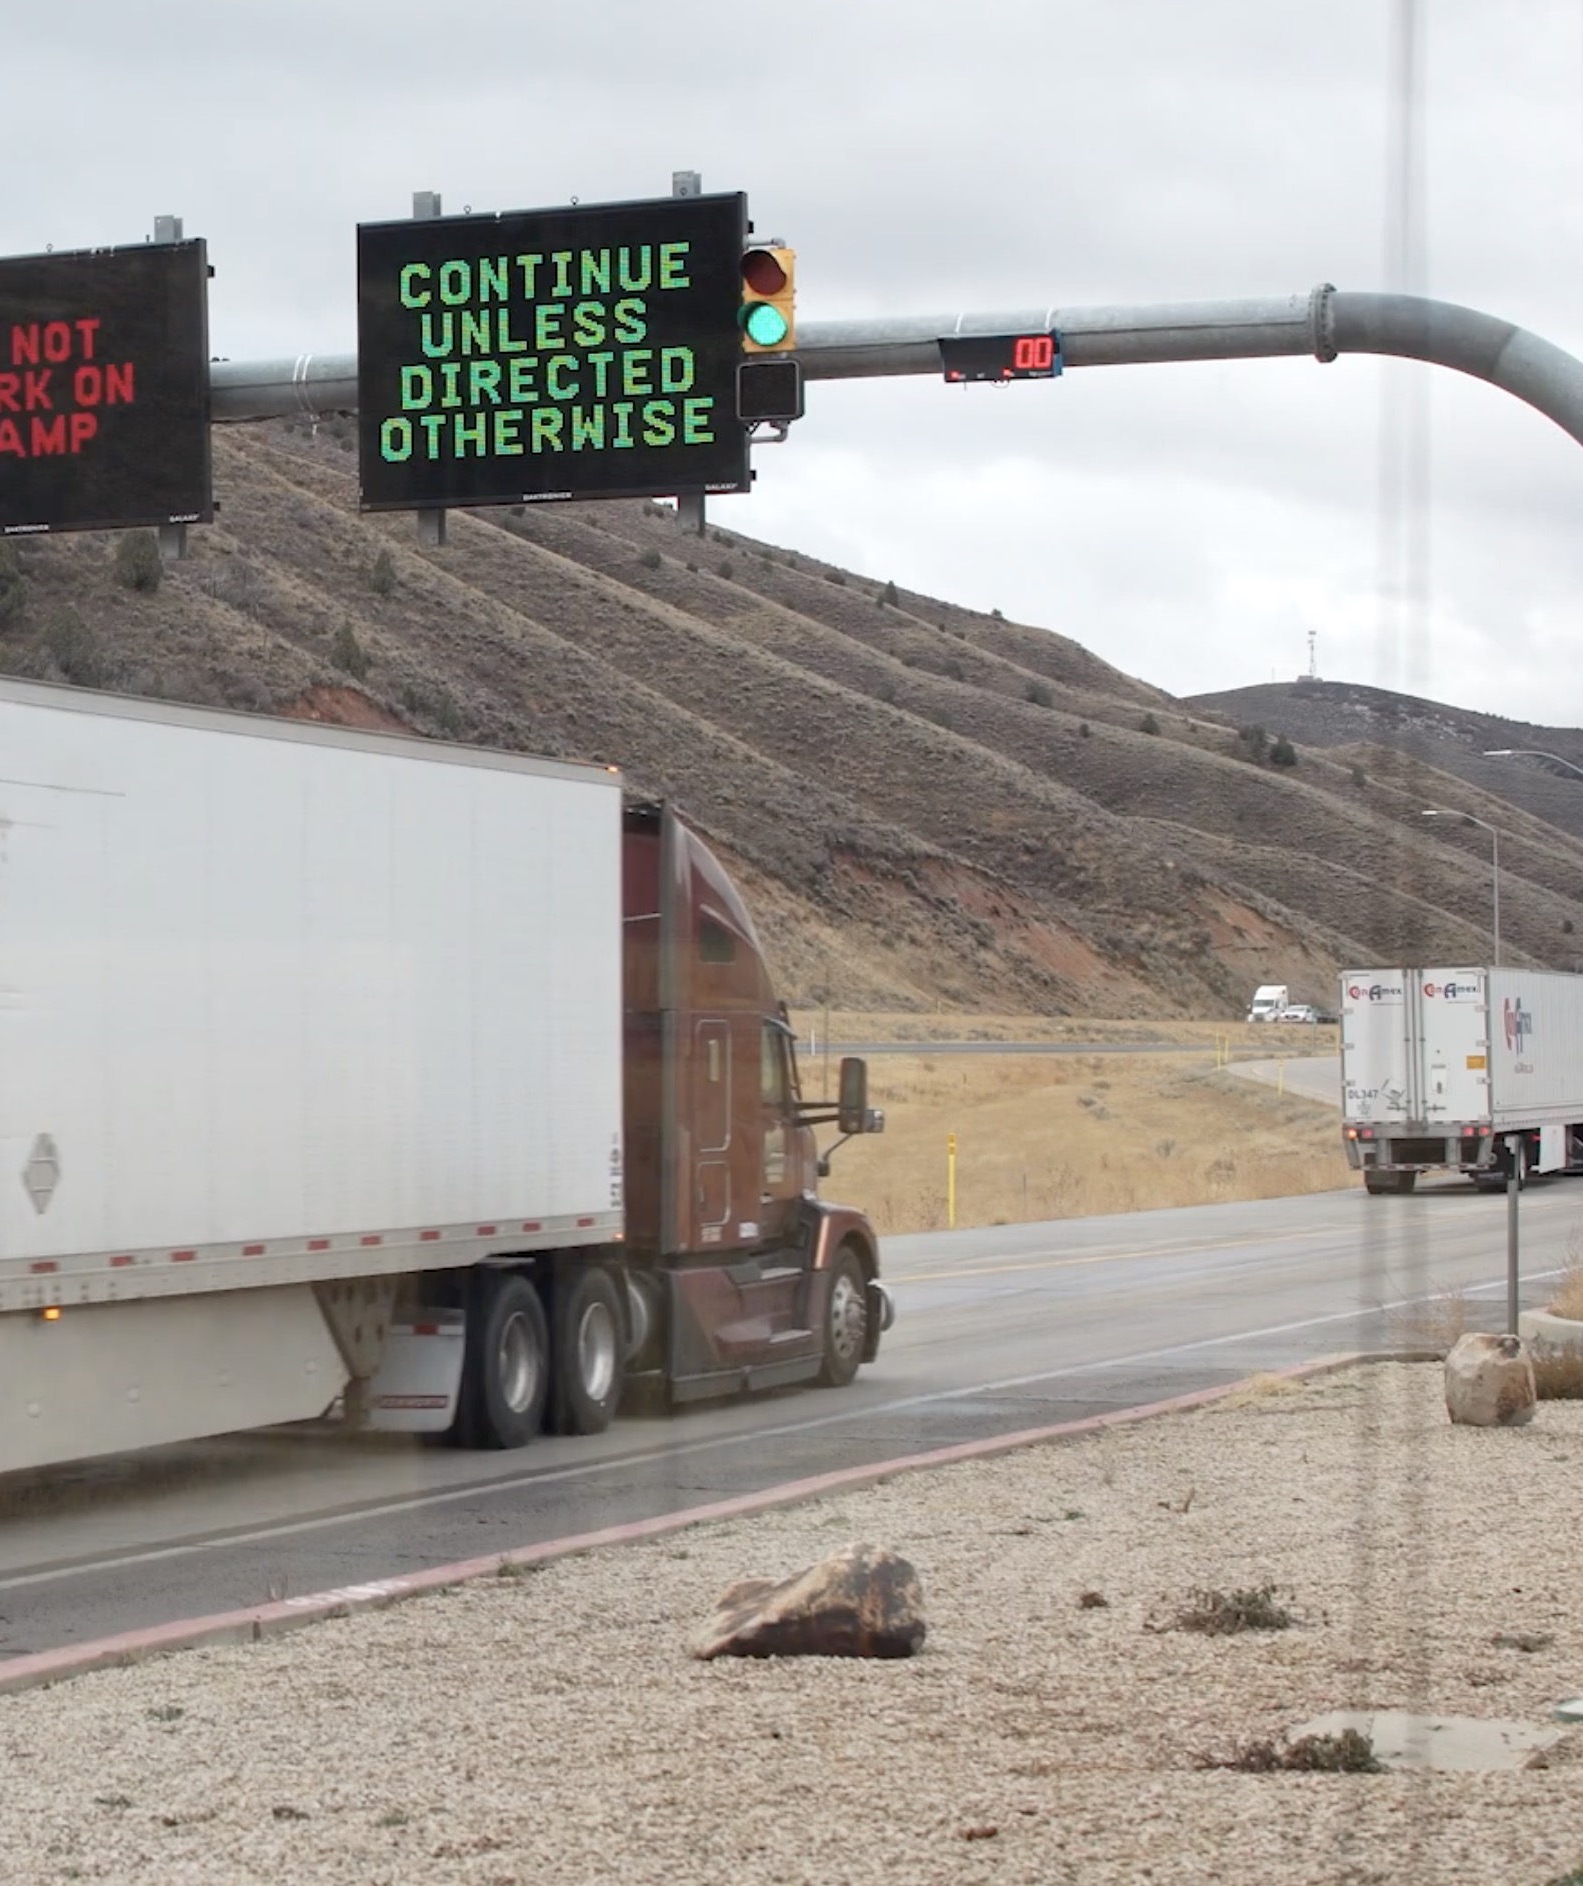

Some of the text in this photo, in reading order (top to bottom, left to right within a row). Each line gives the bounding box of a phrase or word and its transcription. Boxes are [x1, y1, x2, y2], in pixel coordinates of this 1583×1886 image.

[399, 242, 690, 309] CONTINUE
[11, 317, 101, 366] NOT
[421, 297, 647, 358] UNLESS
[73, 361, 135, 408] ON
[400, 346, 695, 411] DIRECTED
[380, 397, 715, 463] OTHERWISE
